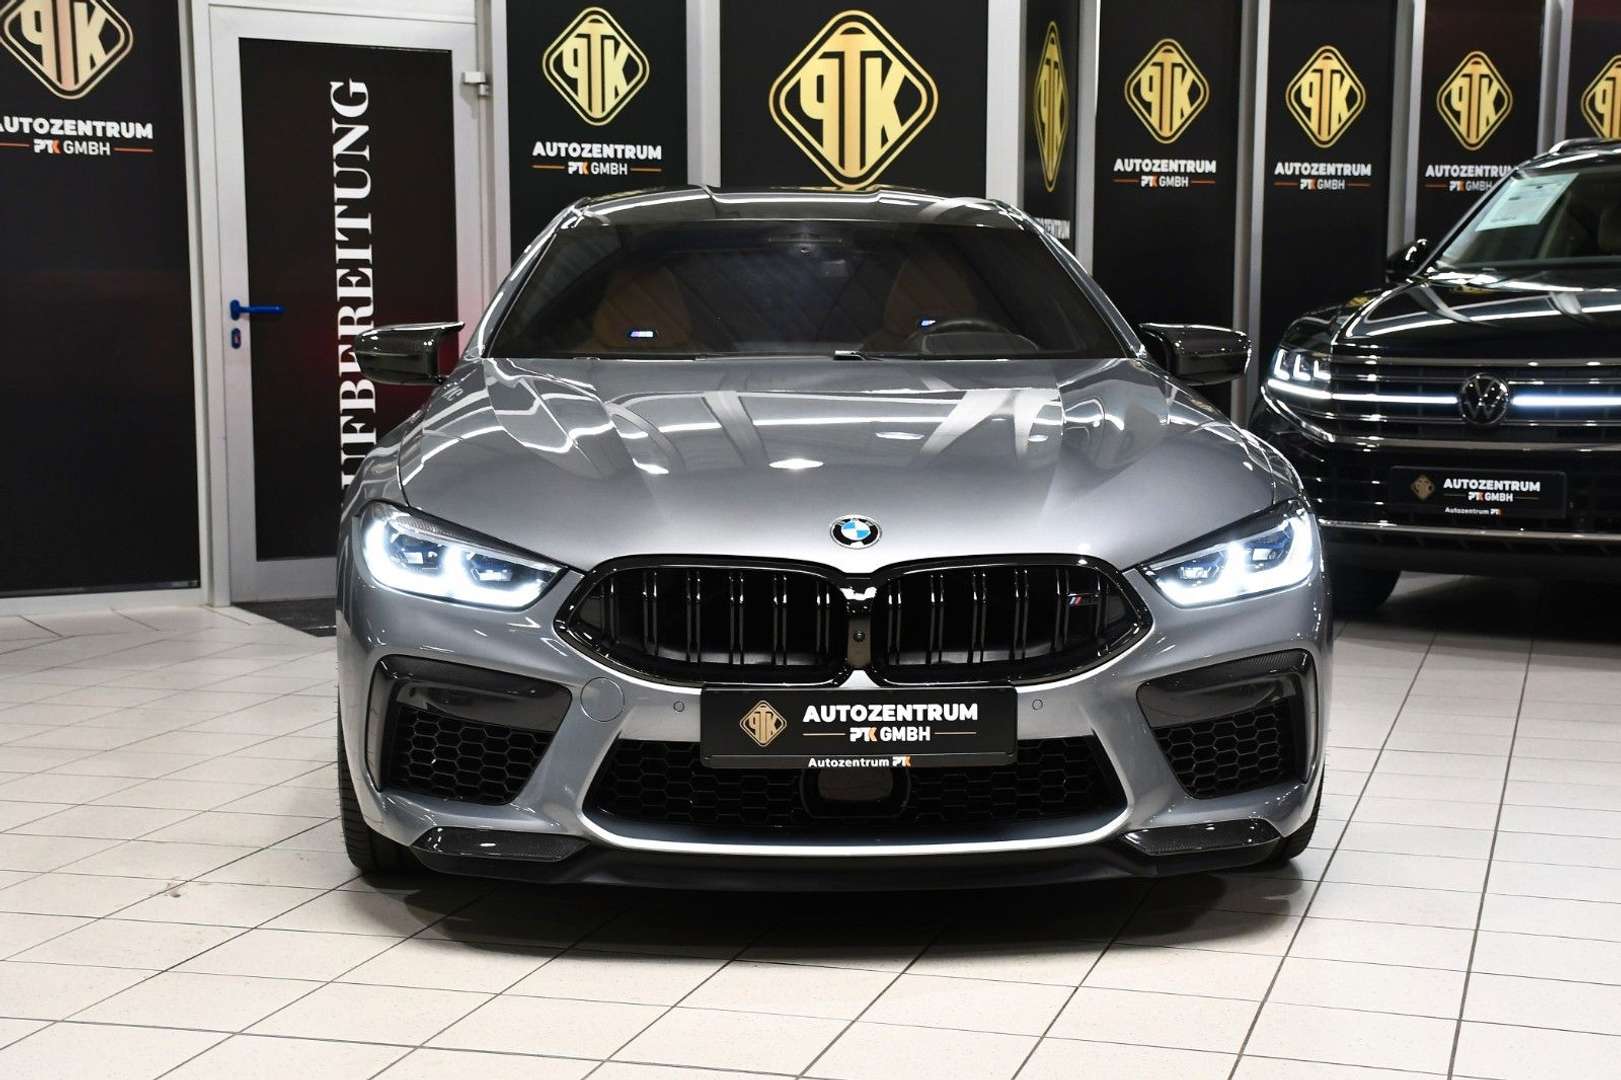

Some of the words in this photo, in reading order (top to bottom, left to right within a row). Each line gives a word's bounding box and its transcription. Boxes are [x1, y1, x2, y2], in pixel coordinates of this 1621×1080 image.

[33, 139, 61, 154] PTK
[63, 140, 112, 156] GMBH
[532, 141, 662, 161] AUTOZENTRUM
[567, 161, 589, 175] PTK
[590, 162, 628, 176] GMBH
[1113, 158, 1217, 174] AUTOZENTRUM
[1274, 161, 1372, 177] AUTOZENTRUM
[1425, 164, 1512, 178] AUTOZENTRU
[1140, 175, 1158, 188] PTK
[1159, 176, 1189, 188] GMBH
[1317, 178, 1346, 190] GMBH
[1443, 478, 1541, 492] AUTOZENTRUM
[1484, 492, 1514, 502] GMBH
[802, 703, 978, 723] AUTOZENTRUM
[849, 726, 878, 742] PTK
[880, 726, 931, 742] GMBH
[807, 756, 890, 768] Autozentrum
